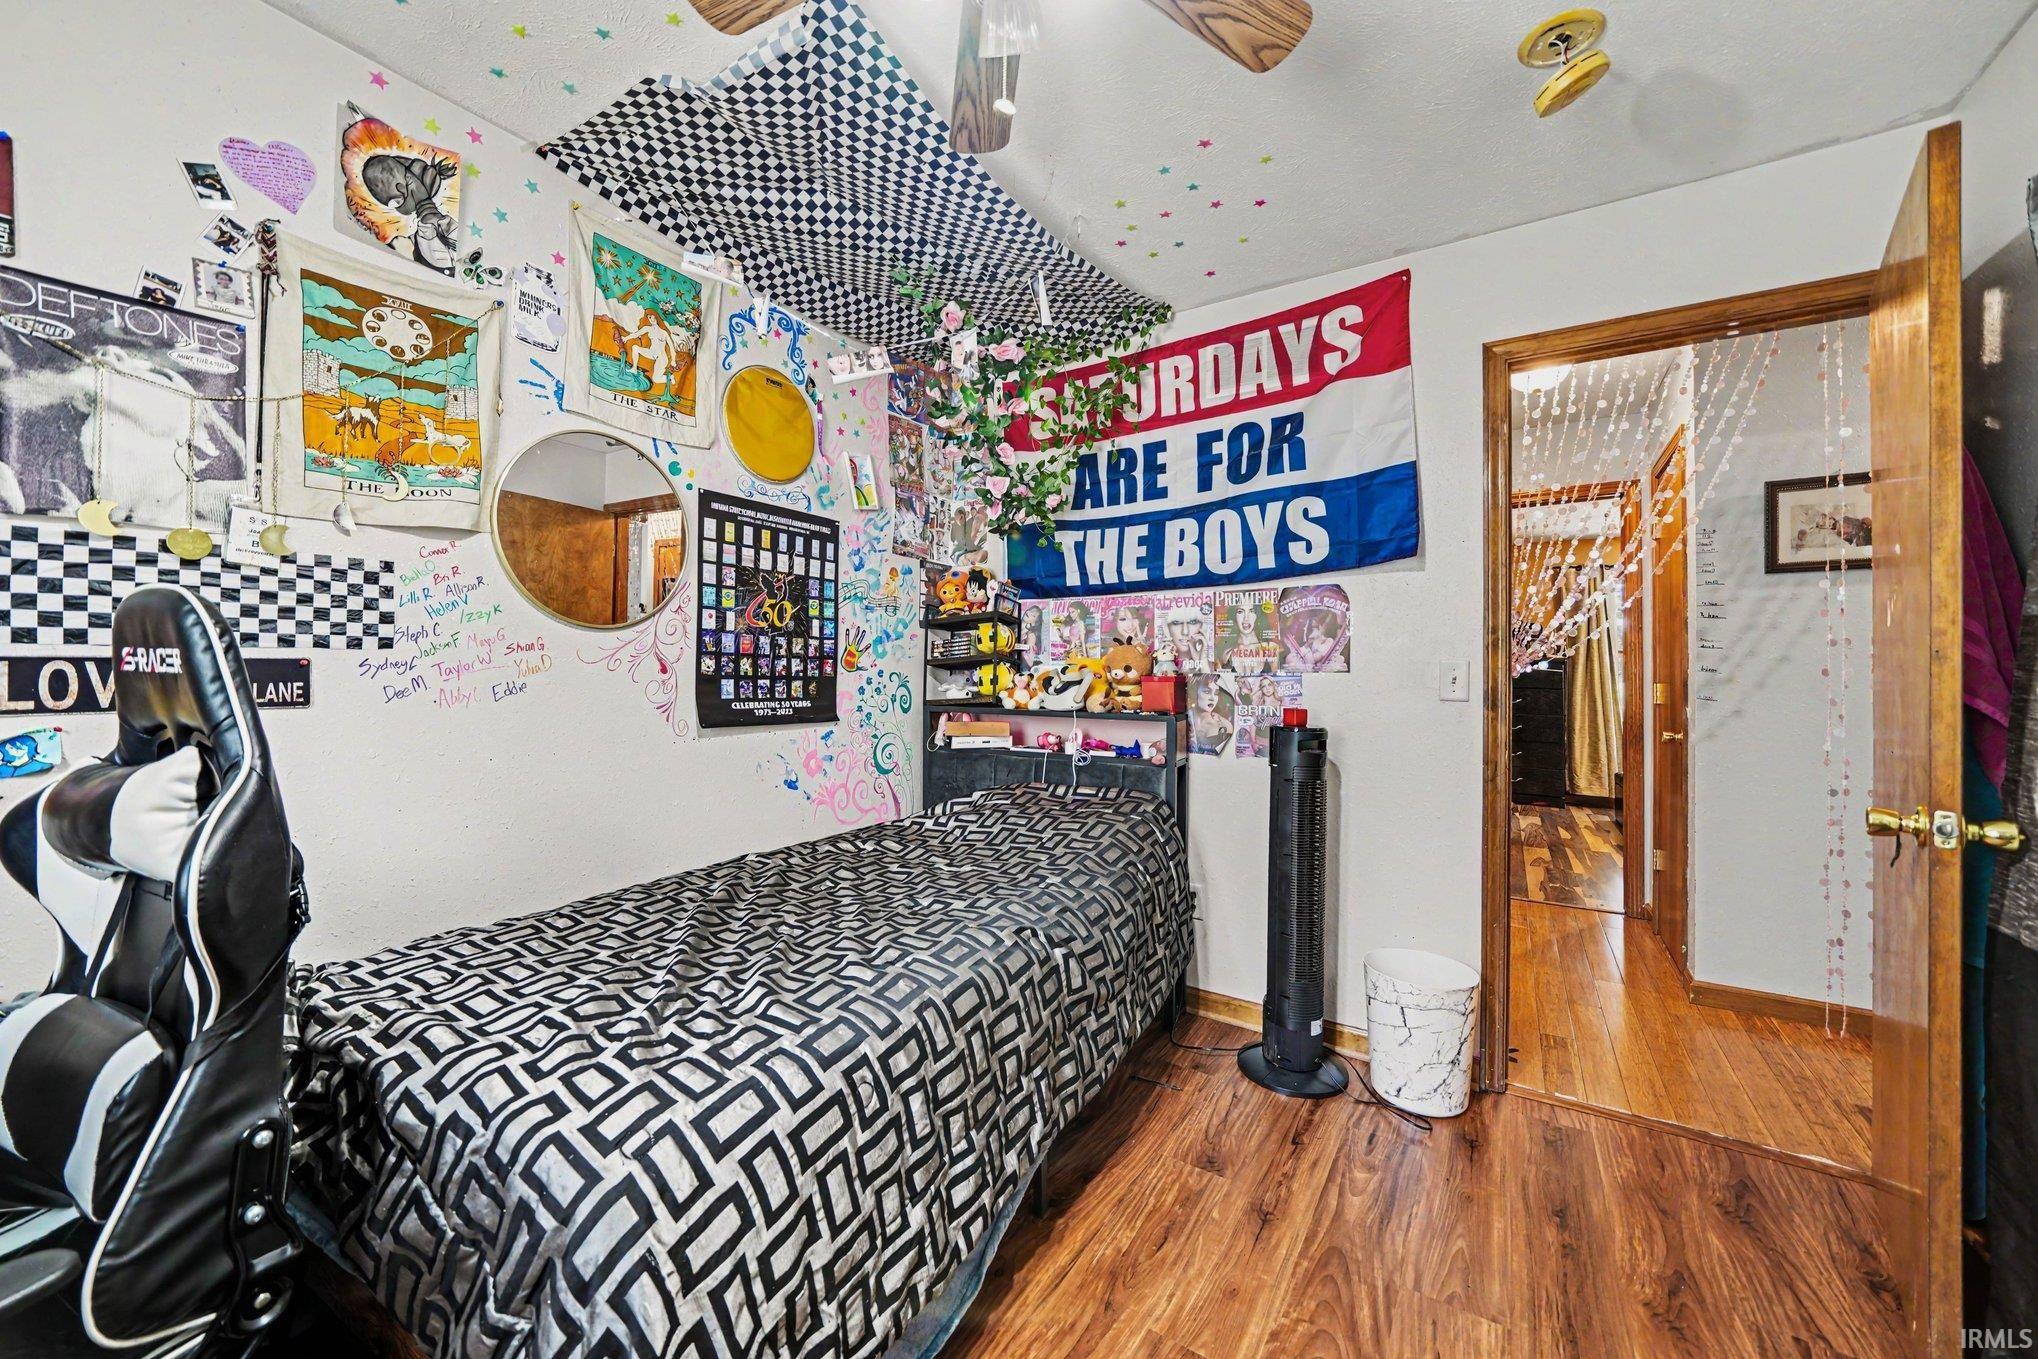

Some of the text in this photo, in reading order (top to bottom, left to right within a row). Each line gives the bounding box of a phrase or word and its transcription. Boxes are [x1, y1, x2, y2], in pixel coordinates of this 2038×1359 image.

[0, 271, 241, 356] DEFTONES
[519, 296, 545, 313] DRINK
[611, 392, 679, 422] THE STAR
[1070, 411, 1307, 511] ARE FOR
[346, 480, 385, 495] THE
[1054, 496, 1330, 588] THE BOYS
[1215, 590, 1278, 607] PREMIERE
[424, 599, 460, 620] Helen
[493, 604, 503, 615] K
[395, 625, 428, 645] Steph
[358, 656, 408, 679] Sydney
[431, 659, 475, 680] Taylor
[252, 681, 304, 703] LANE
[491, 680, 528, 703] Eddie
